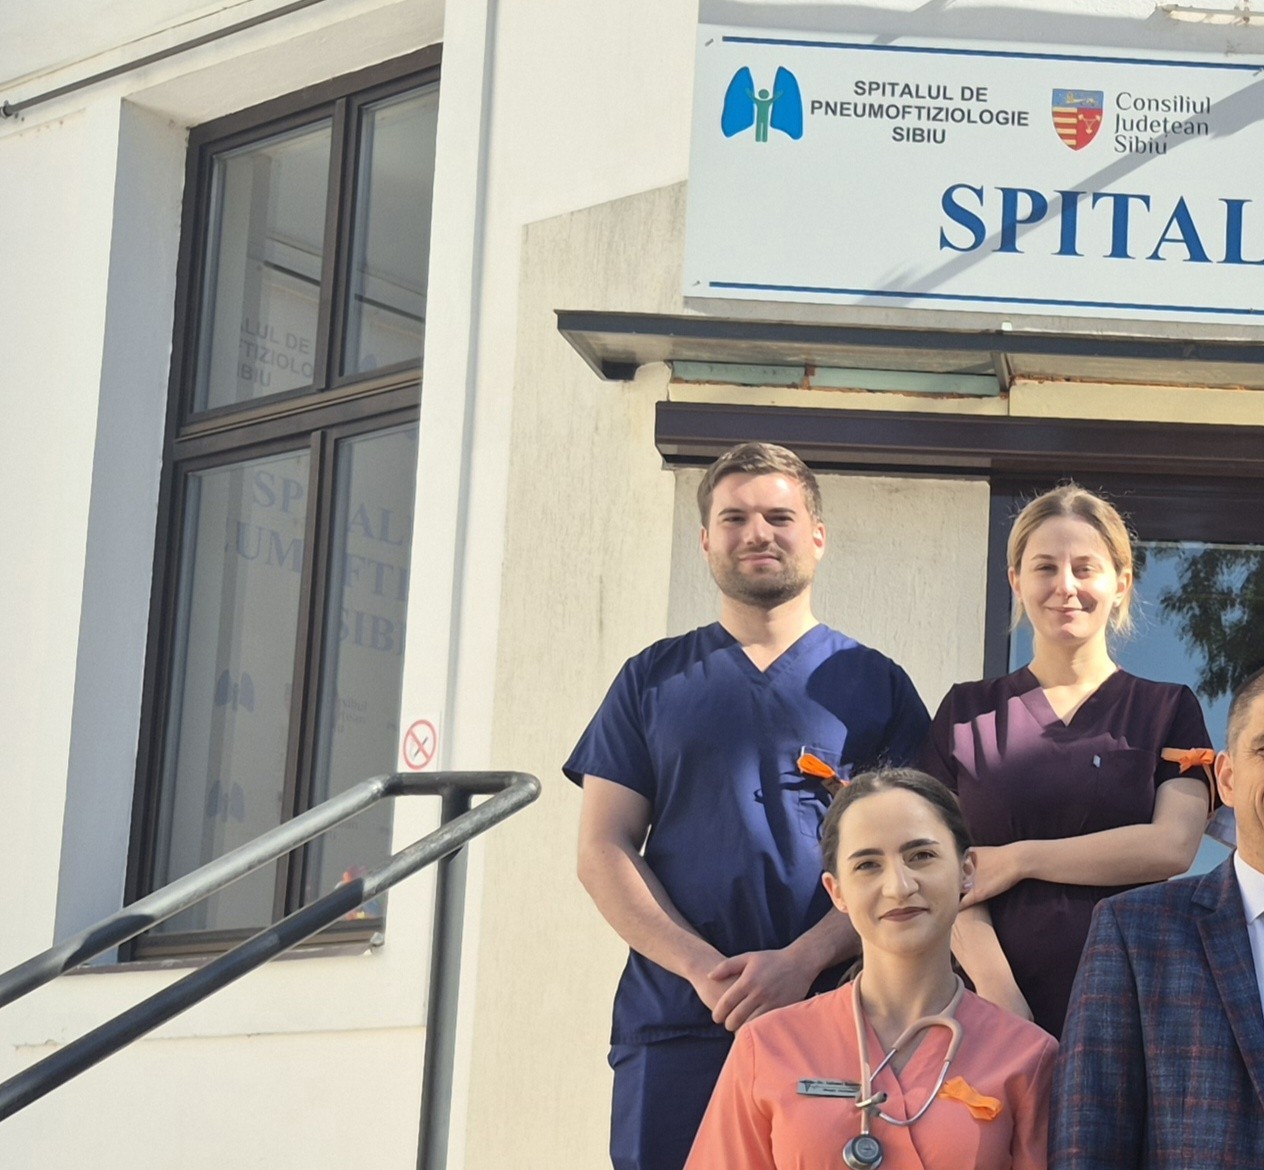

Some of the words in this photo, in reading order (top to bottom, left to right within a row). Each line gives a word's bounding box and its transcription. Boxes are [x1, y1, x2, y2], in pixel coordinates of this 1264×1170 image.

[853, 80, 954, 103] SPITALUL
[961, 86, 988, 102] DE
[810, 100, 1030, 127] PNEUMOFTIZIOLOGIE
[1115, 92, 1211, 115] Consiliul
[892, 126, 946, 144] SIBIU
[1114, 113, 1209, 137] Județean
[1114, 135, 1167, 155] Sibiu
